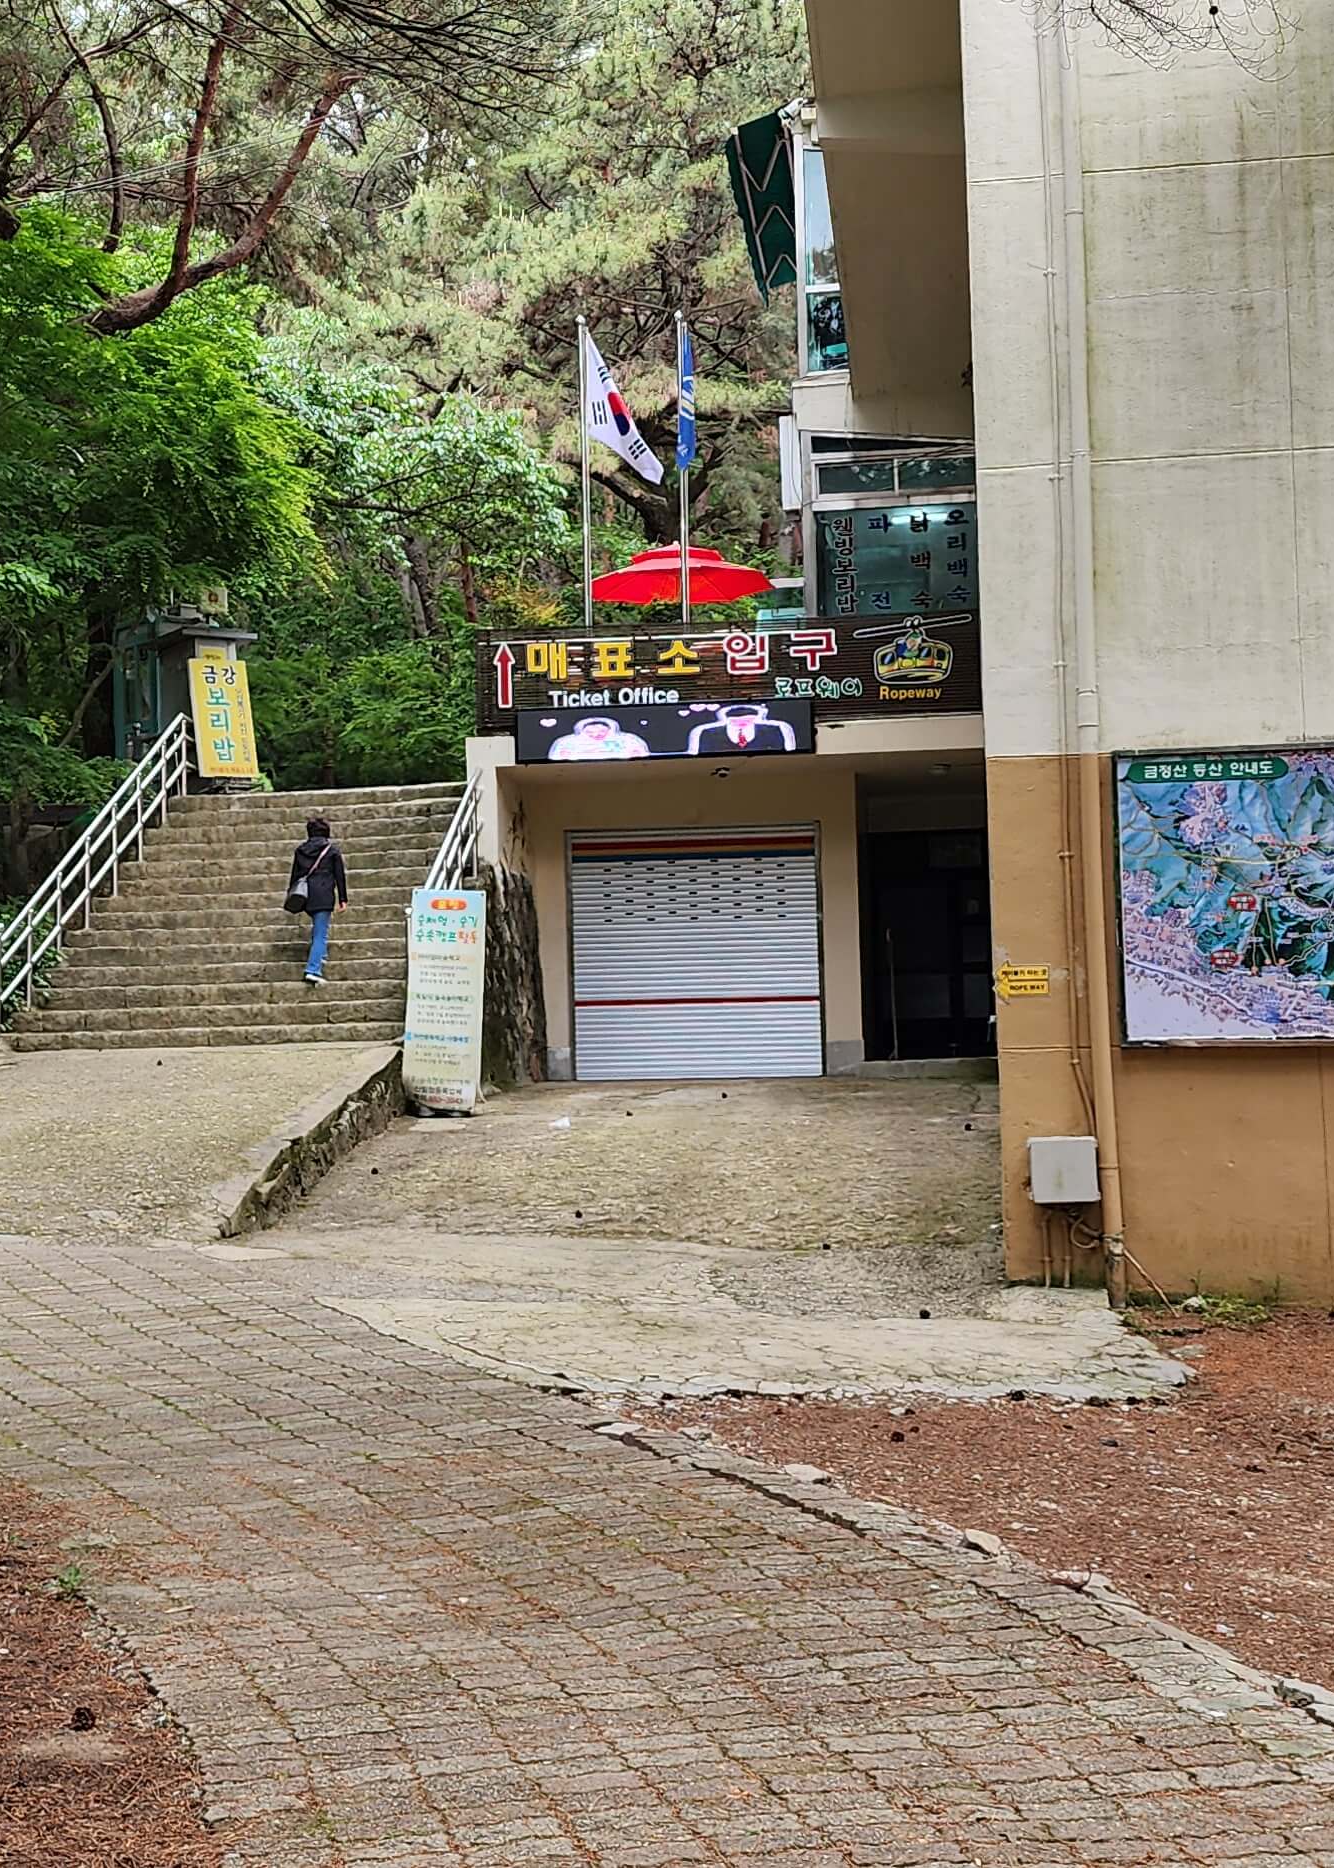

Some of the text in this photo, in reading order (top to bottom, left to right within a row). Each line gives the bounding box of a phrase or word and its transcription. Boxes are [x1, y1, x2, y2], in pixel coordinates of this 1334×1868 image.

[868, 514, 892, 610] 파전
[943, 510, 971, 603] 오리백숙
[526, 628, 838, 681] 매표소 입구
[202, 665, 237, 686] 금강
[548, 687, 679, 707] Ticket Office
[774, 676, 863, 699] 로프웨이
[879, 685, 942, 701] Ropeway
[206, 688, 236, 763] 보리밥
[1144, 761, 1274, 779] 금정산 등산 안내도
